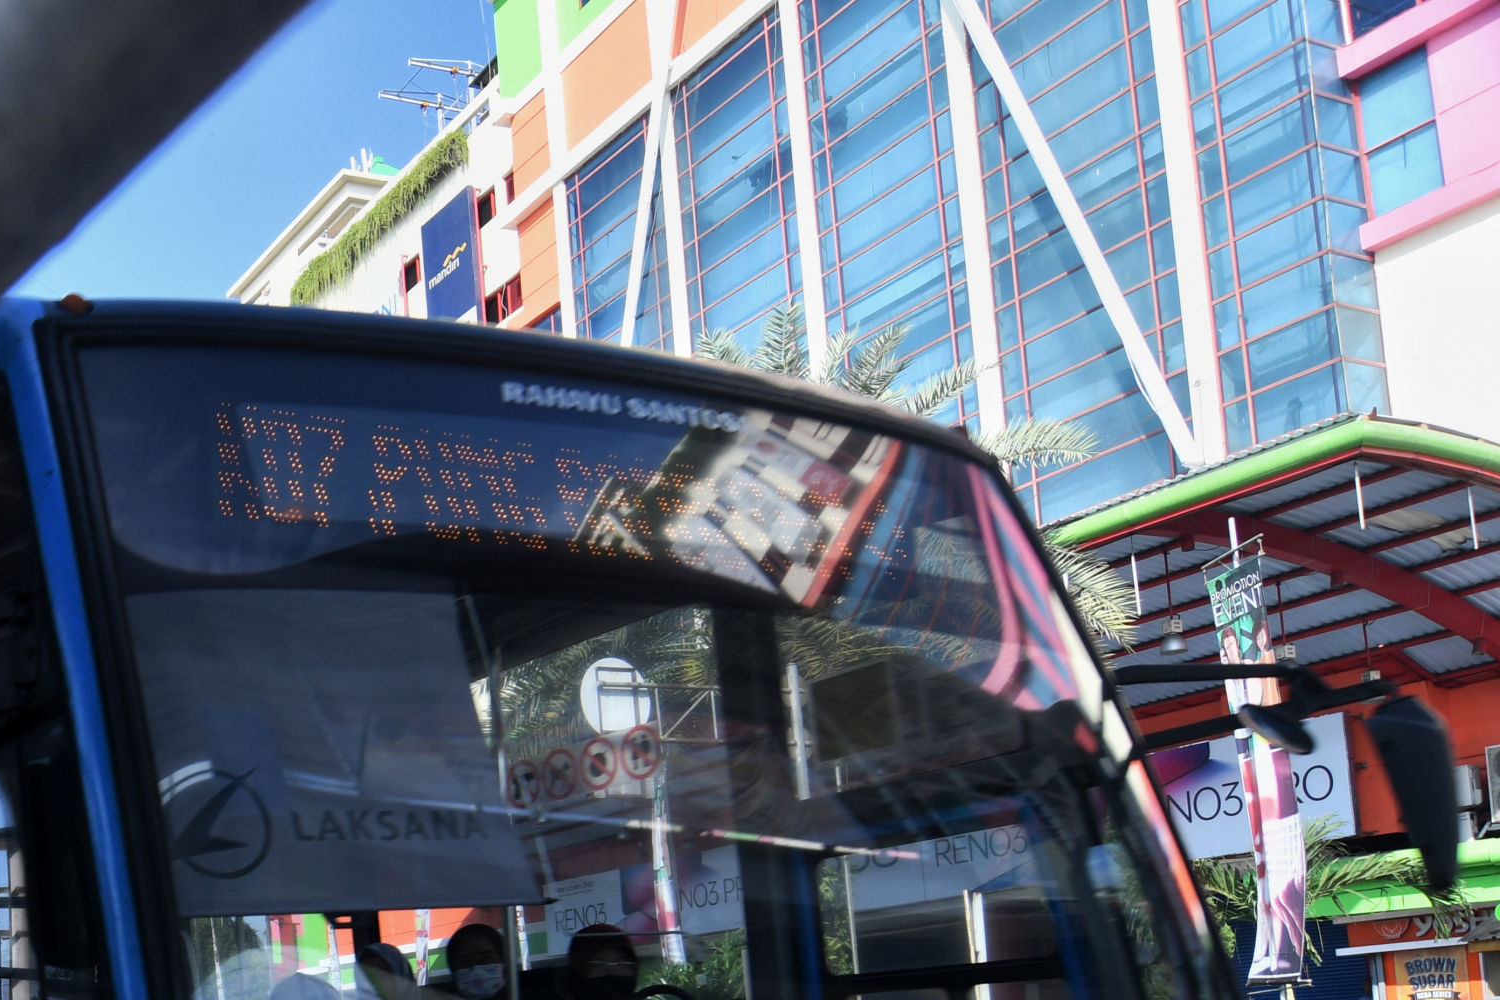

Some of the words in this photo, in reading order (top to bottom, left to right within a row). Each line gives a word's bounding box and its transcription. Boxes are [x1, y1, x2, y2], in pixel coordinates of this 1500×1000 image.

[501, 381, 623, 416] RAHAYU
[1210, 570, 1260, 605] PROMOTION
[1212, 582, 1262, 628] EVENT
[290, 808, 489, 842] LAKSANA
[934, 827, 1028, 868] RENO3
[554, 903, 607, 932] RENO3
[1404, 957, 1457, 976] BROWN
[1409, 973, 1455, 990] SUGAR
